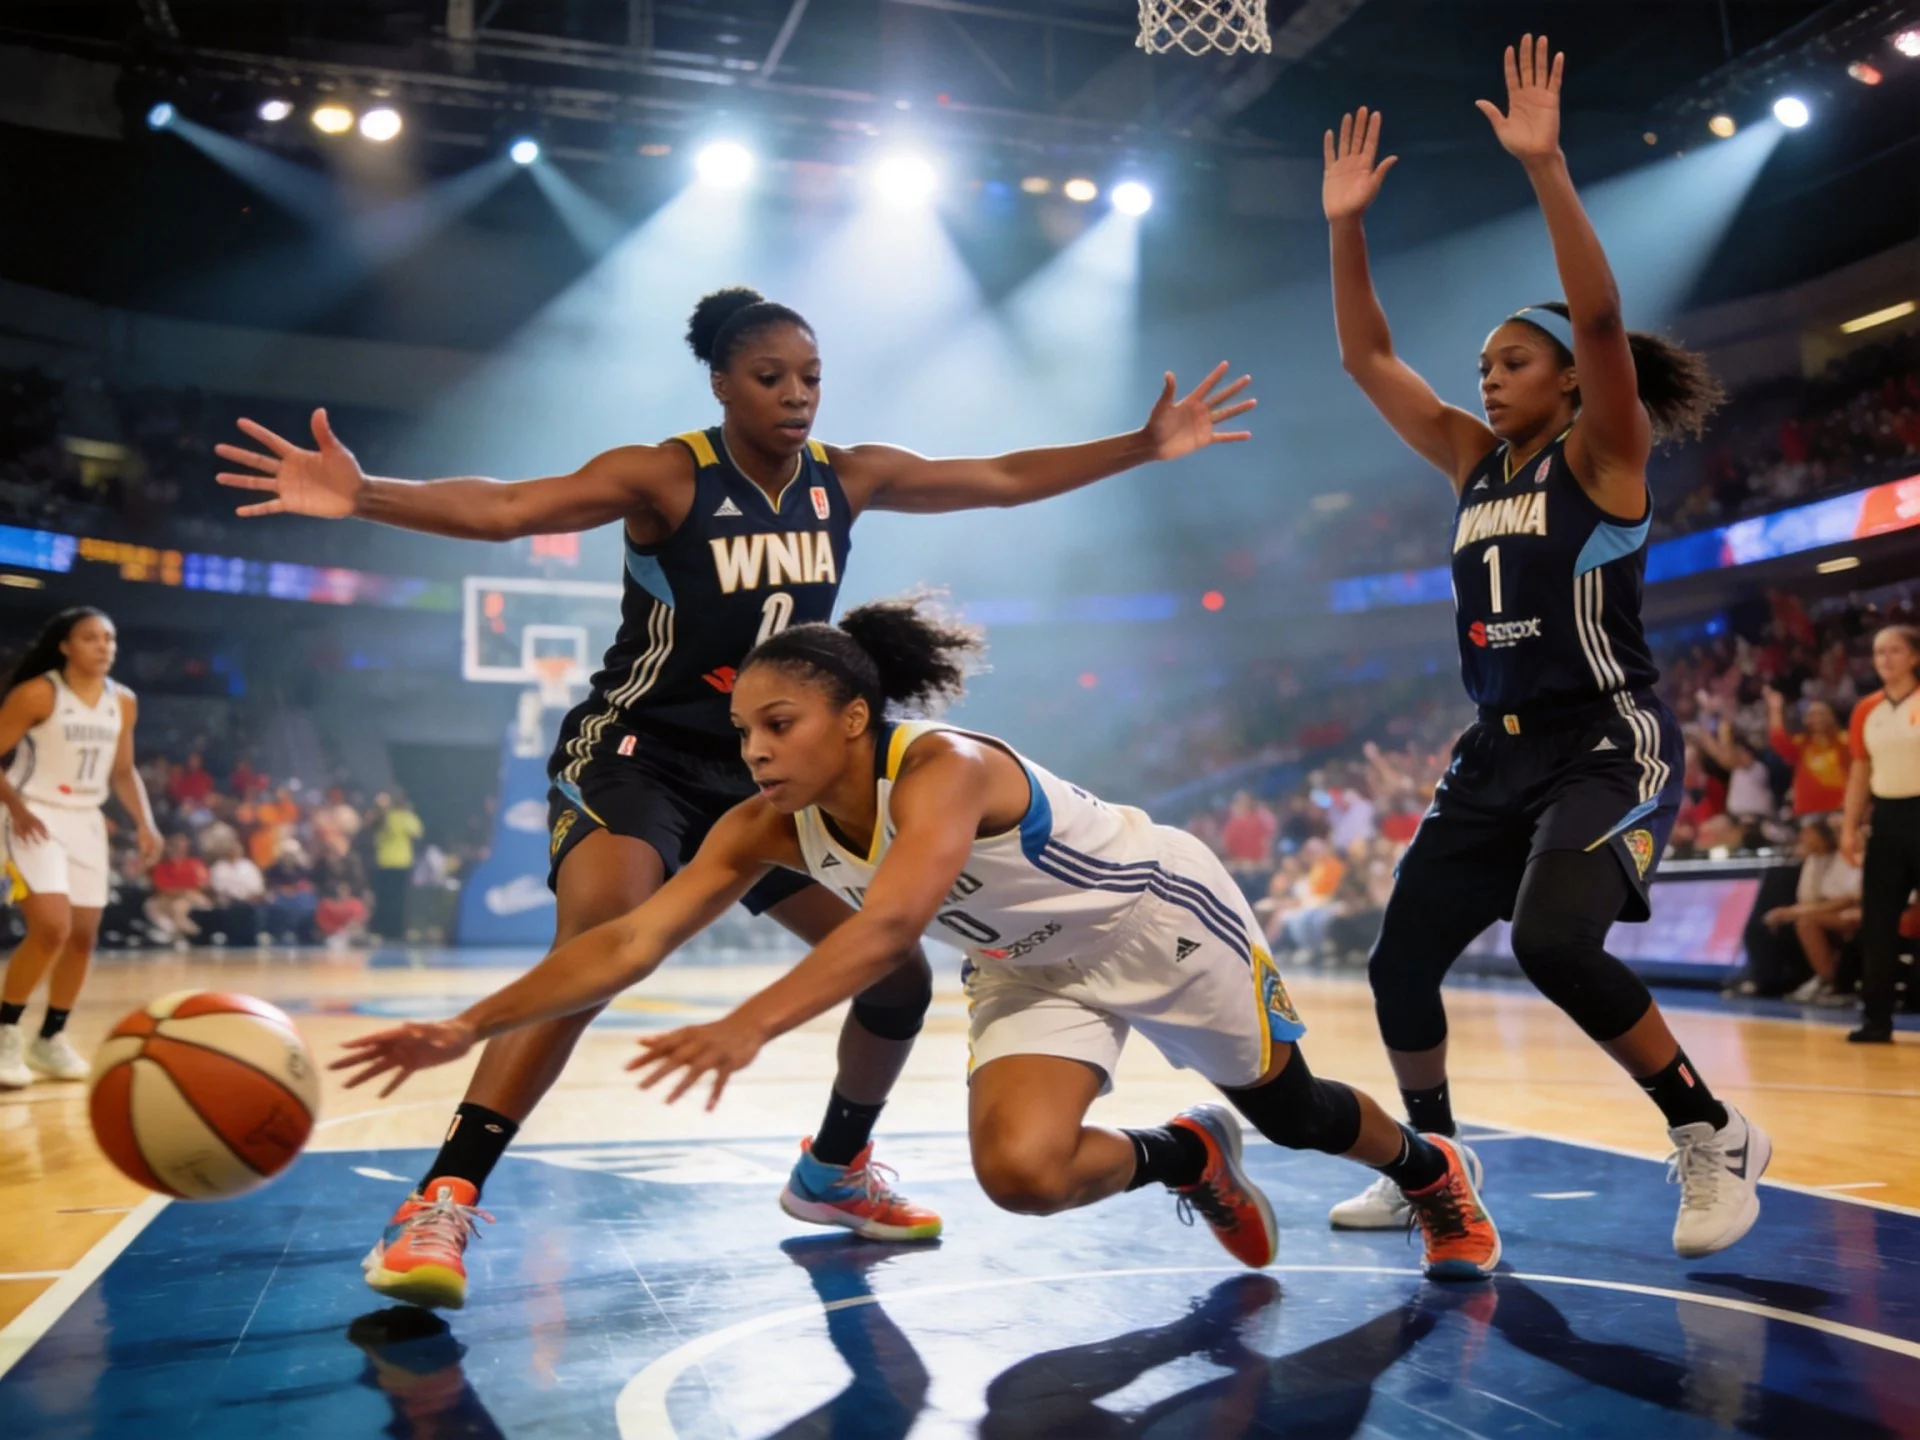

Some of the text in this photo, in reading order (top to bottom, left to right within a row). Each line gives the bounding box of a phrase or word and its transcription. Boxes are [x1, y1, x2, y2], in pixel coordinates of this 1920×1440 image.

[709, 531, 836, 594] WNIA
[1482, 545, 1502, 614] 1
[938, 910, 1001, 944] 0
